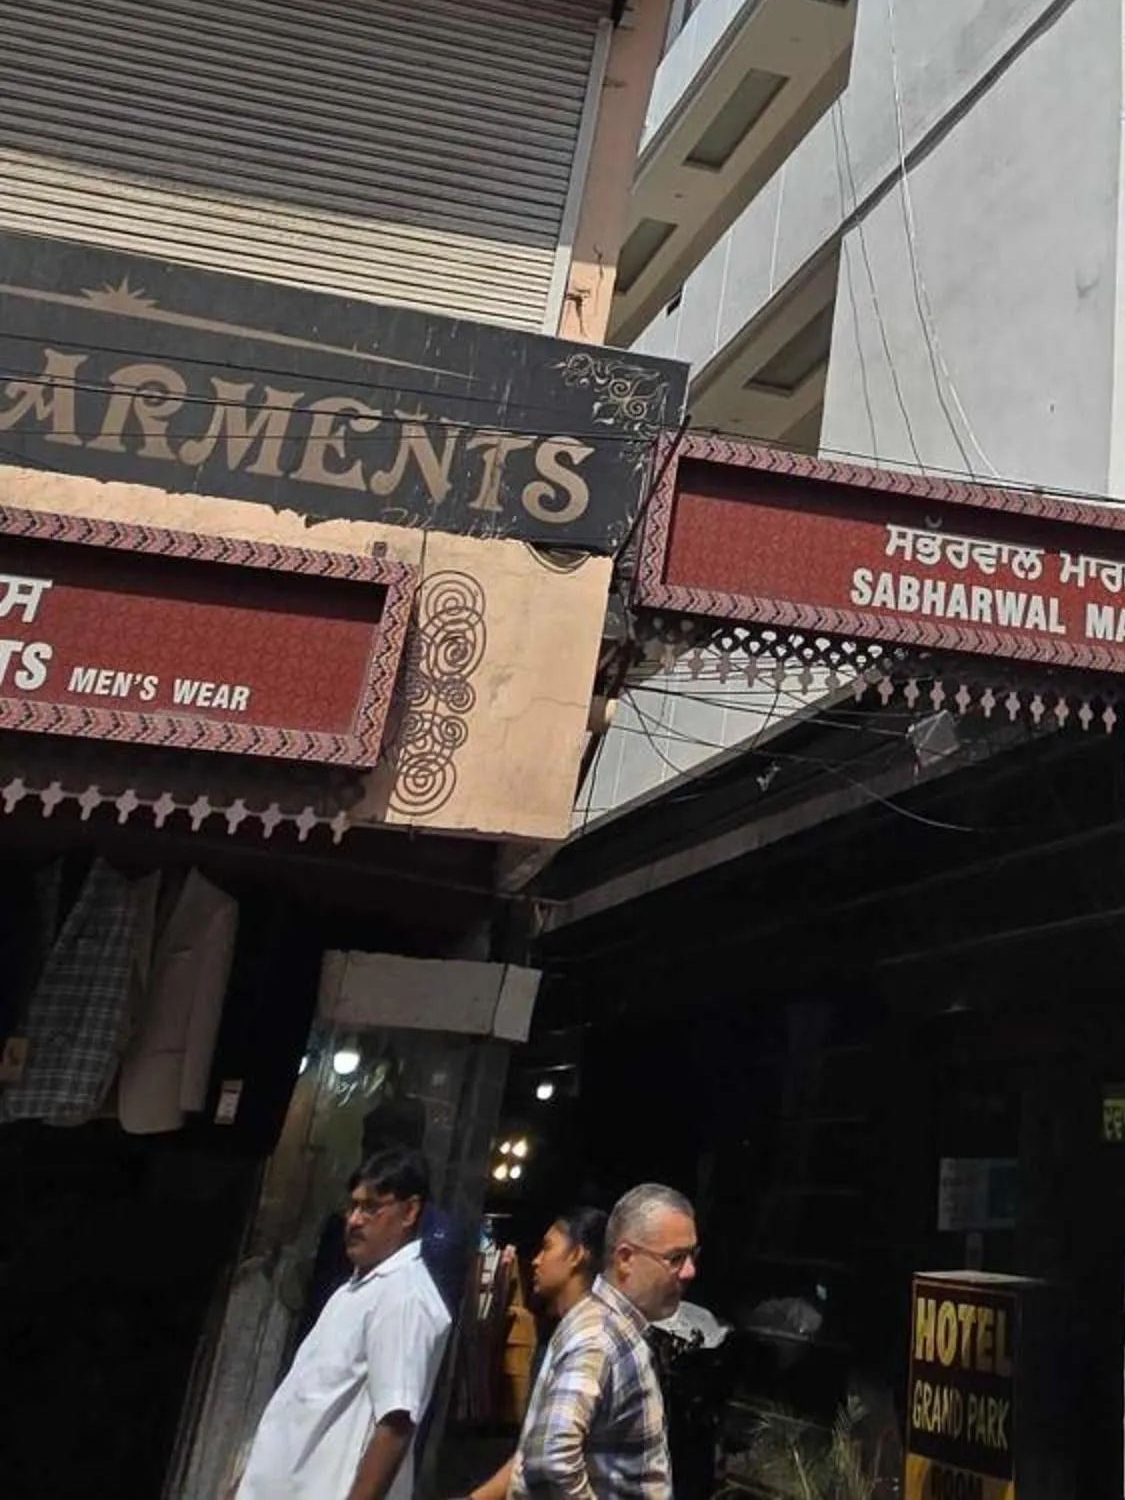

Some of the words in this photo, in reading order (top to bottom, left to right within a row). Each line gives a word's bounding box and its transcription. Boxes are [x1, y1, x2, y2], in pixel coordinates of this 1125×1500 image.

[850, 567, 1067, 636] SABHARWAL
[67, 666, 159, 702] MEN'S
[172, 678, 251, 712] WEAR
[914, 1297, 1013, 1378] HOTEL
[912, 1379, 964, 1437] GRAND
[966, 1395, 1010, 1452] PARK
